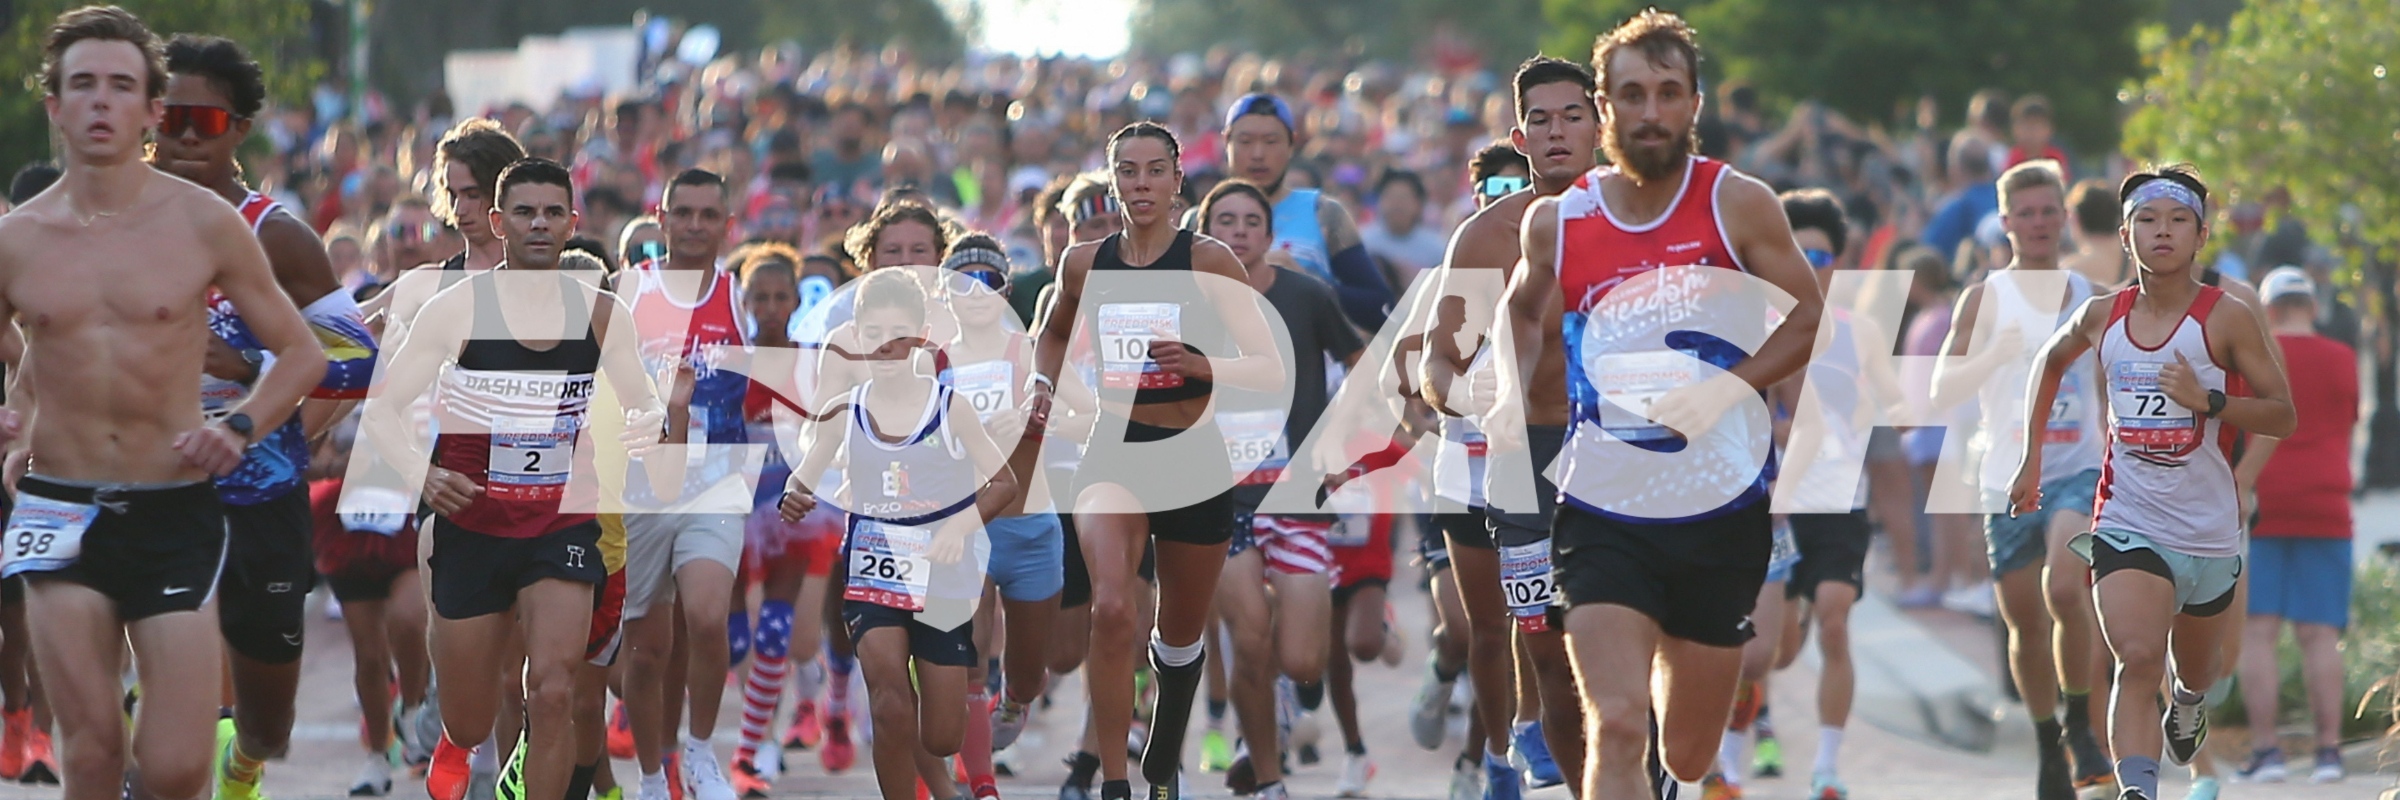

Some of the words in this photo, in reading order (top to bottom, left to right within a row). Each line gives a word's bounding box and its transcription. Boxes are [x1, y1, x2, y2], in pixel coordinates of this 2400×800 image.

[464, 375, 522, 397] DASH
[972, 389, 1005, 412] 07
[2135, 395, 2167, 416] 72
[1229, 440, 1275, 460] 668
[523, 451, 541, 472] 2
[16, 531, 55, 557] 98
[859, 554, 914, 581] 262
